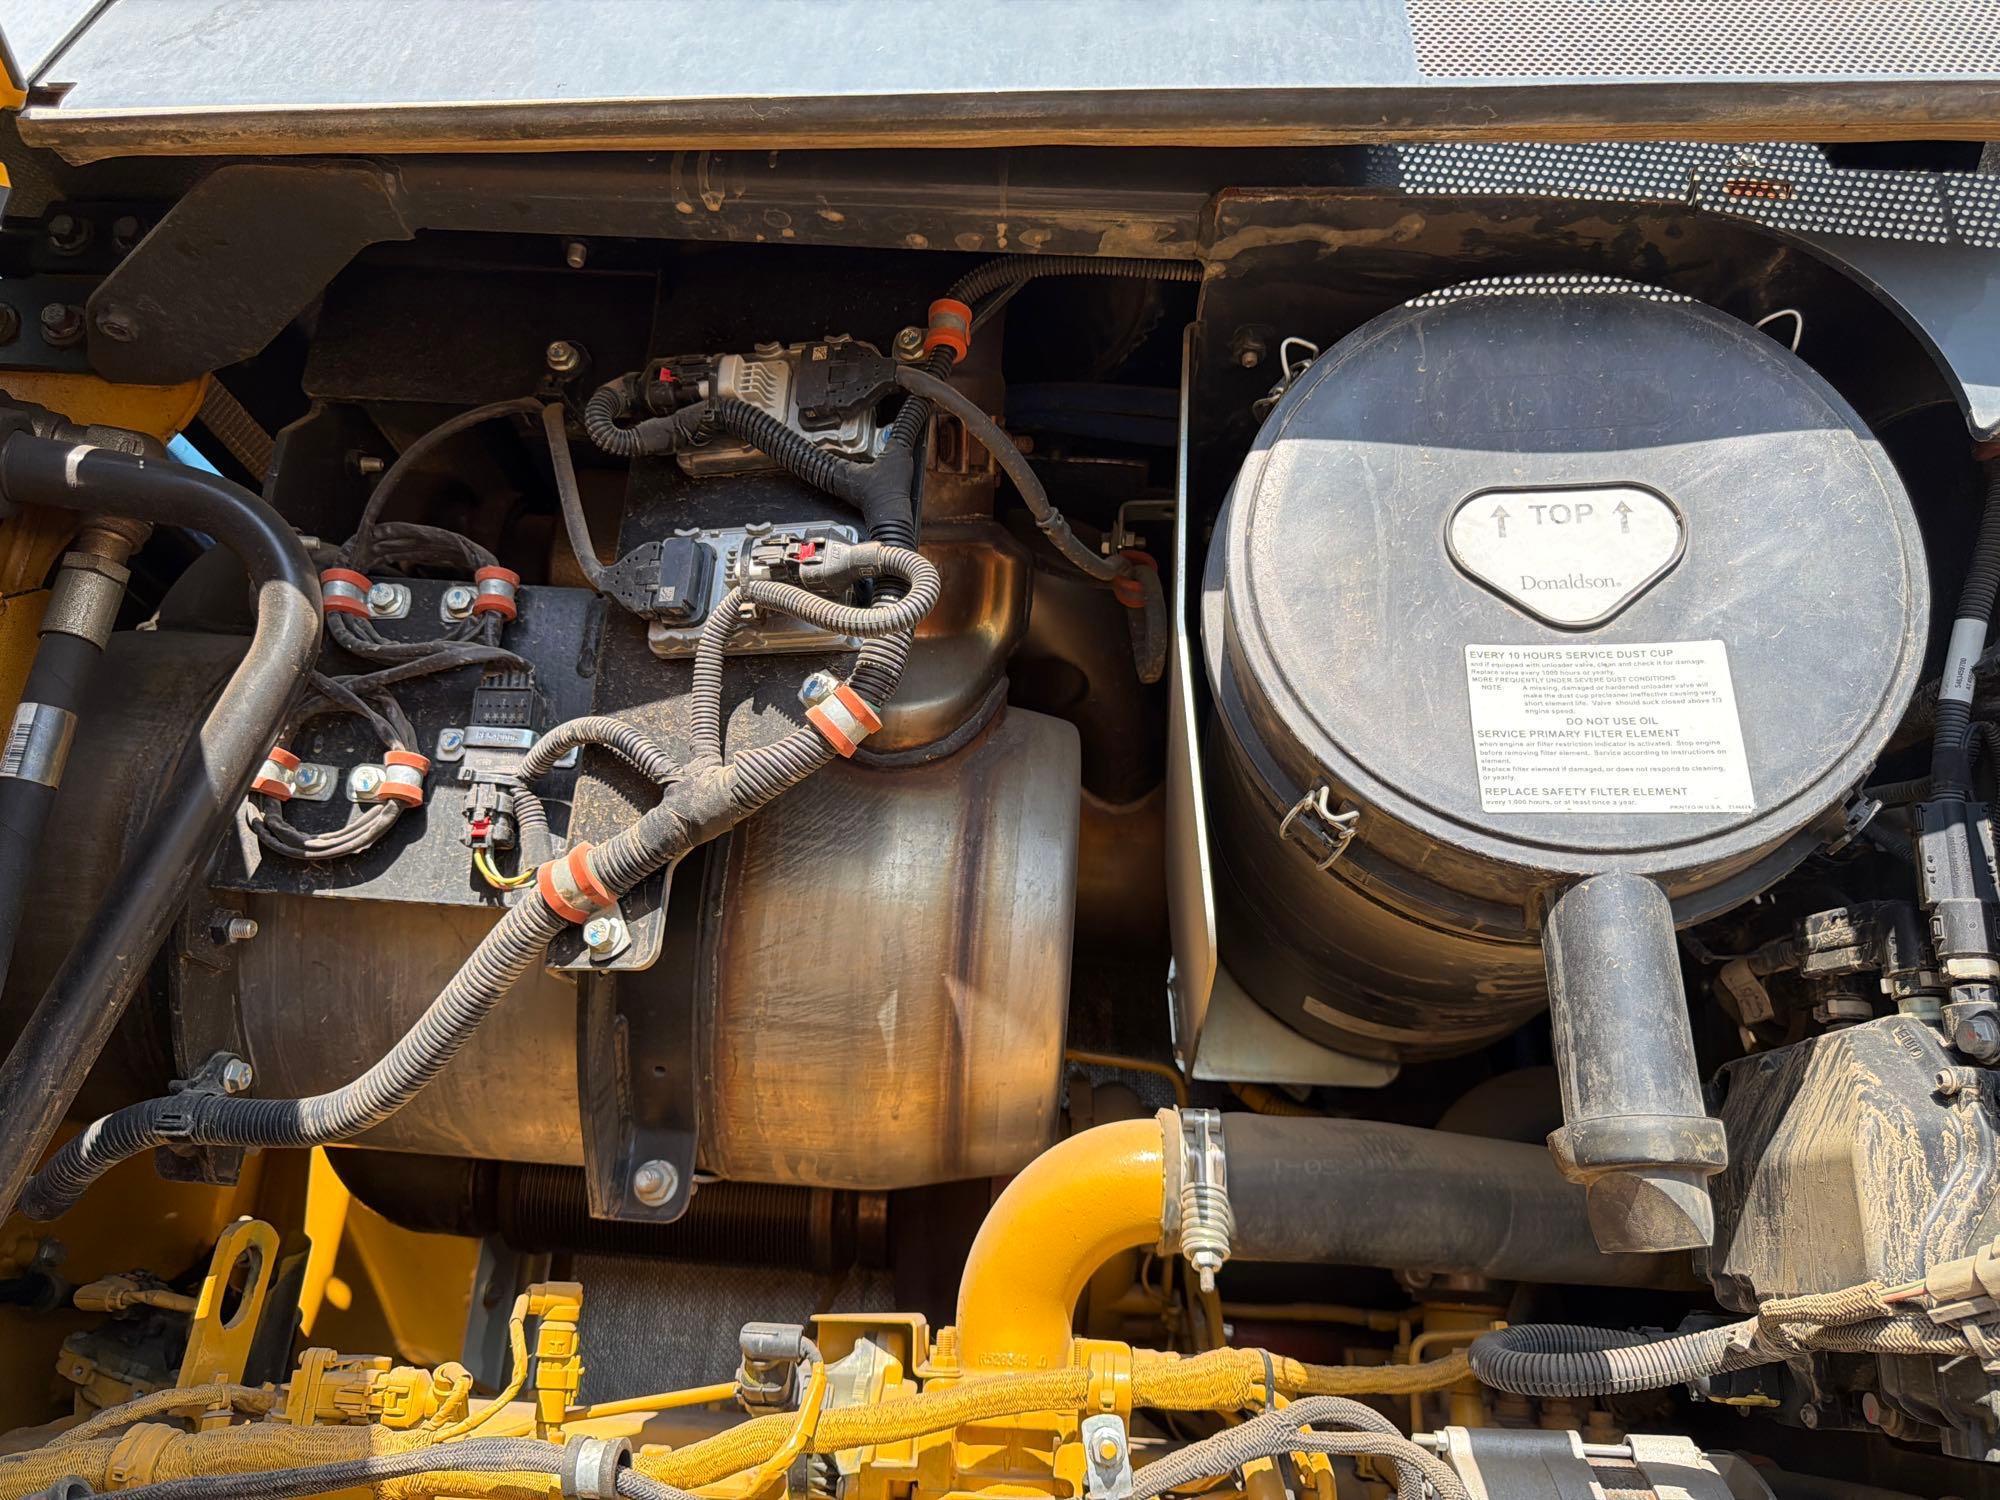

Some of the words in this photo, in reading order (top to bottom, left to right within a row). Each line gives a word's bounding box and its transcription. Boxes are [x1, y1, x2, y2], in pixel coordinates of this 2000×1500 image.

[1528, 503, 1593, 525] TOP
[1470, 651, 1505, 659] EVERY
[1509, 651, 1520, 659] 10
[1523, 651, 1562, 659] HOURS
[1565, 651, 1613, 659] SERVICE
[1616, 650, 1647, 659] DUST
[1650, 649, 1673, 657] CUP
[1495, 676, 1544, 684] FREQUENTLY
[1566, 717, 1583, 726] DO
[1586, 717, 1610, 726] NOT
[1613, 717, 1637, 725] USE
[1639, 716, 1659, 725] OIL
[1477, 730, 1526, 738] SERVICE
[1529, 730, 1581, 738] PRIMARY
[1584, 730, 1623, 738] FILTER
[1626, 729, 1680, 738] ELEMENT
[1485, 788, 1539, 796] REPLACE
[1542, 788, 1587, 796] SAFETY
[1590, 788, 1630, 796] FILTER
[1633, 787, 1688, 796] ELEMENT
